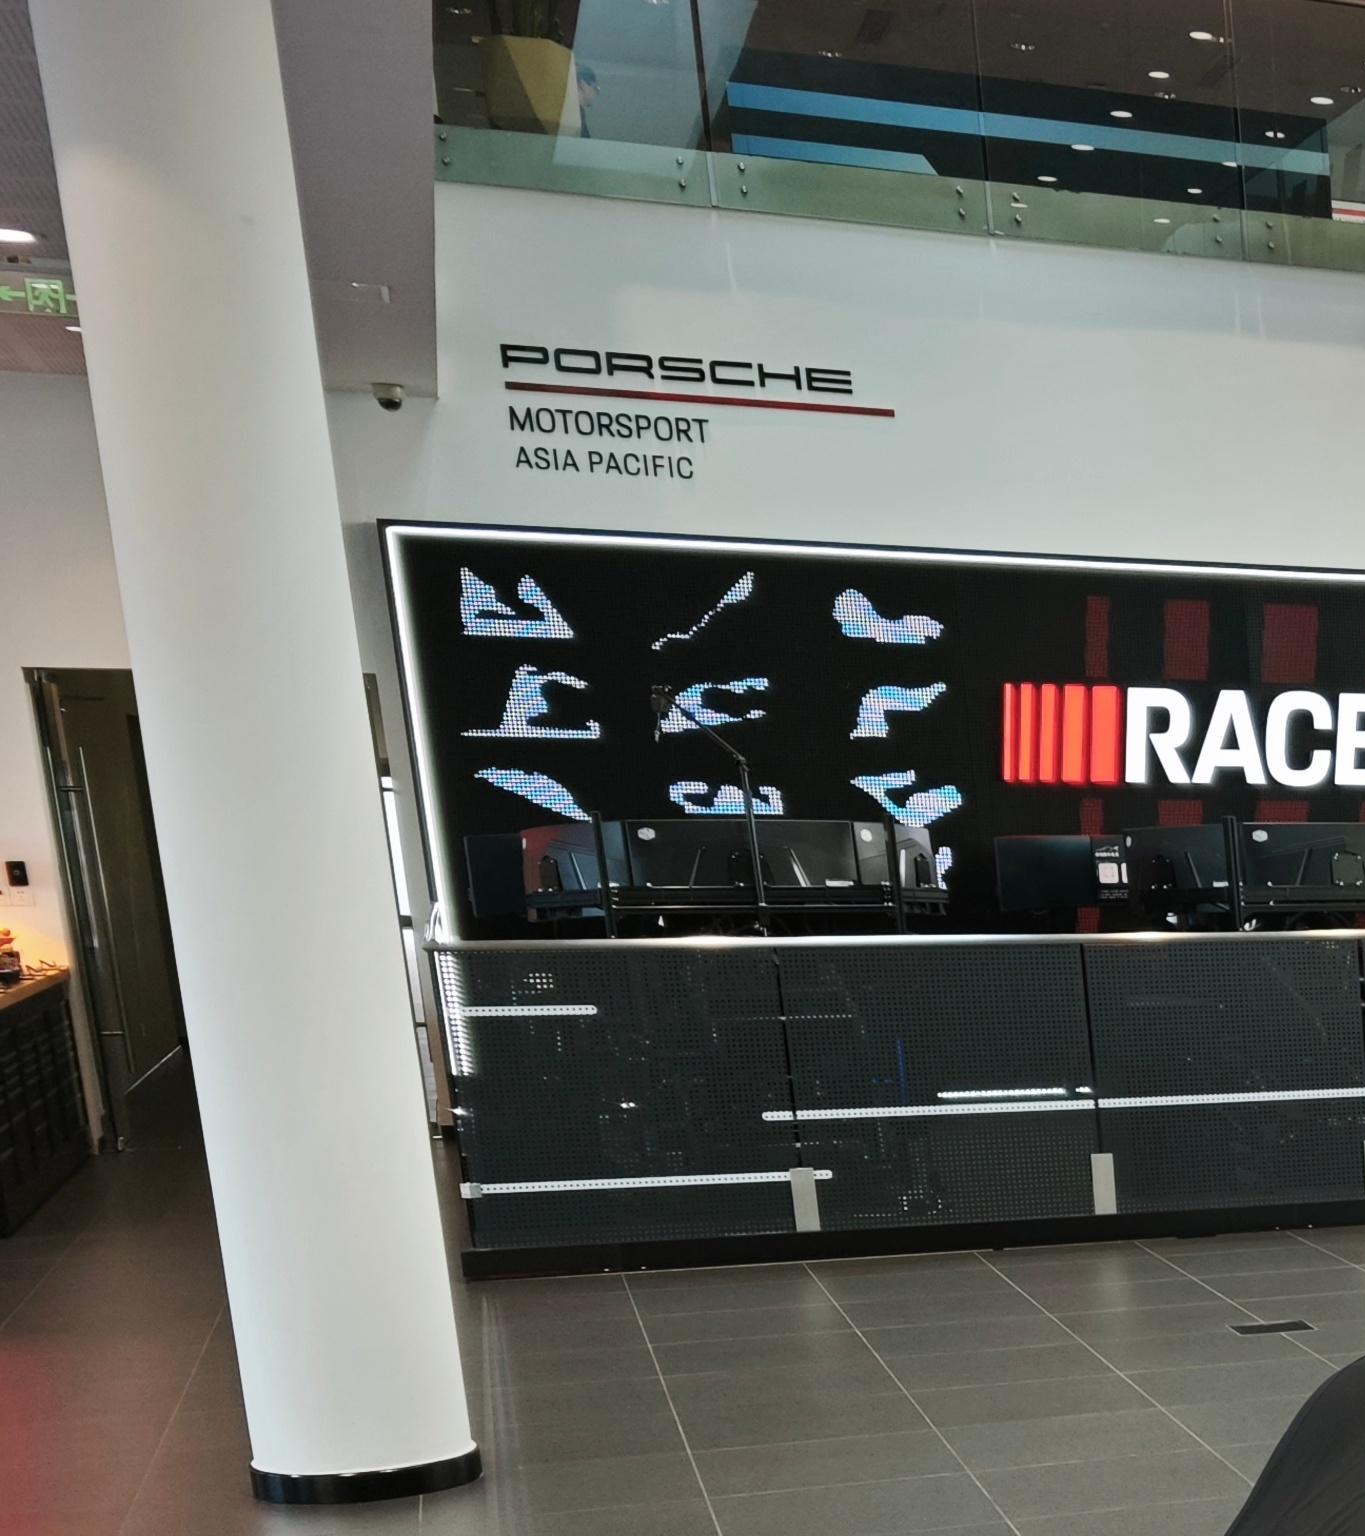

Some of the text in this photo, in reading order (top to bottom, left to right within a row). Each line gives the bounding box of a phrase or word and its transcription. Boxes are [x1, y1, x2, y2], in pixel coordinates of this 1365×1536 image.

[499, 343, 854, 395] PORSCHE
[508, 405, 709, 444] MOTORSPORT
[515, 446, 694, 480] ASIA PACIFIC
